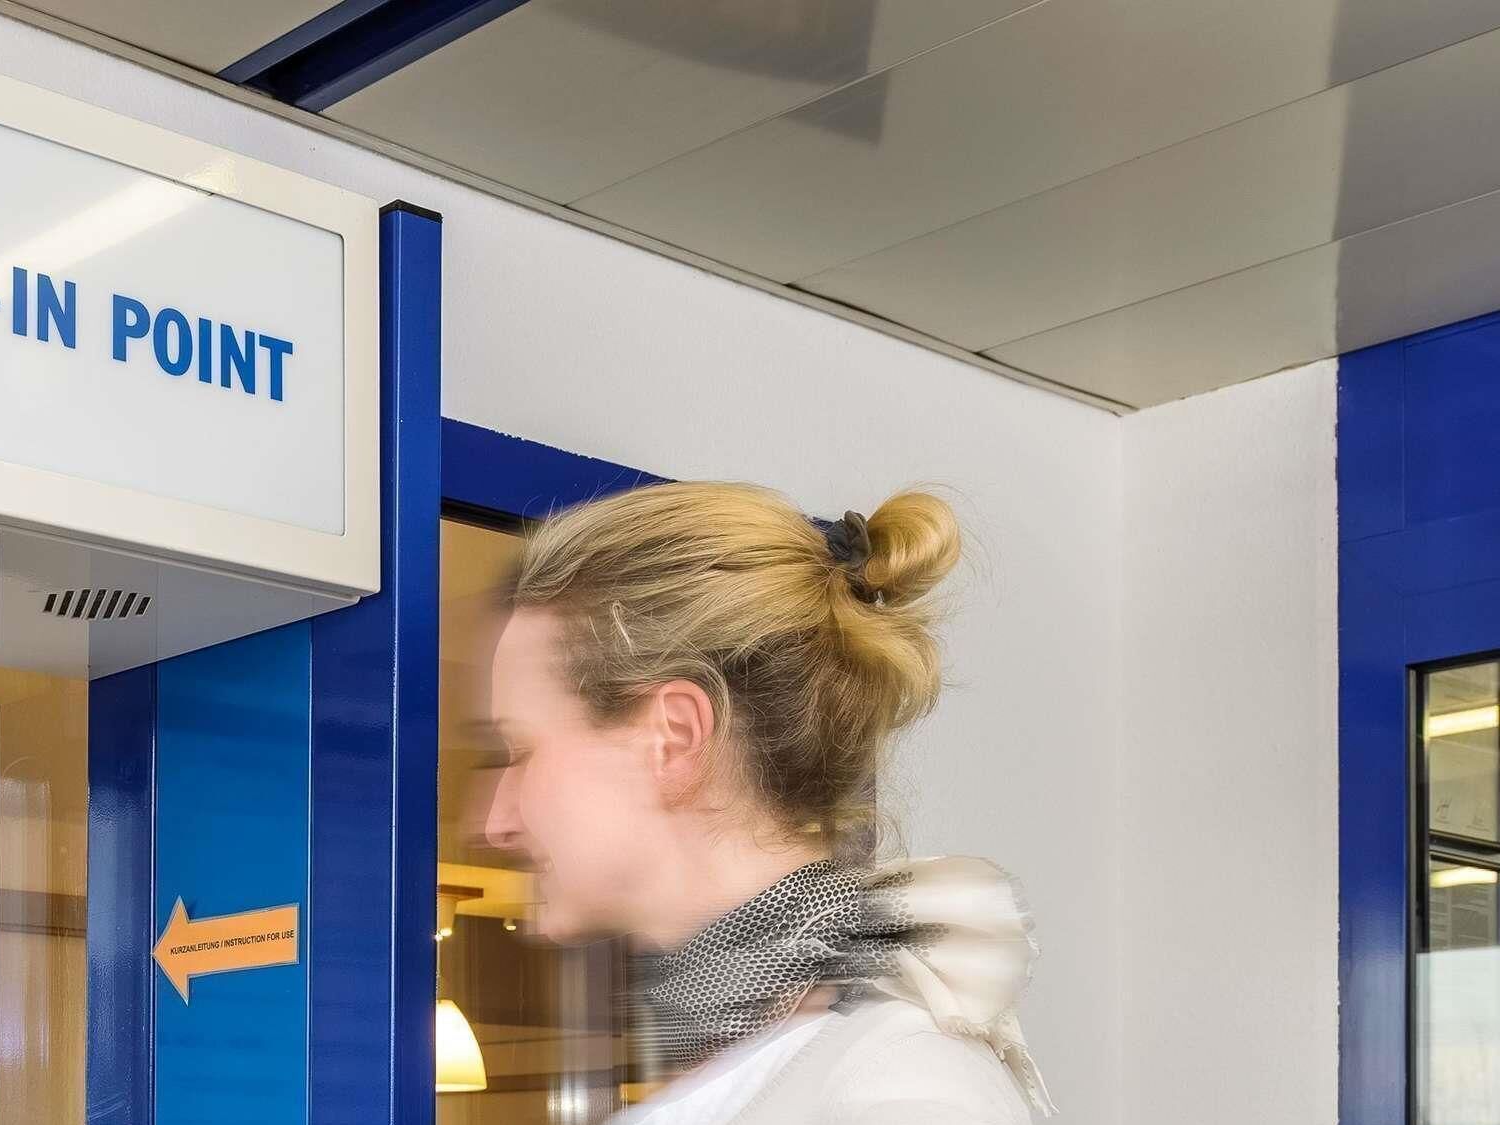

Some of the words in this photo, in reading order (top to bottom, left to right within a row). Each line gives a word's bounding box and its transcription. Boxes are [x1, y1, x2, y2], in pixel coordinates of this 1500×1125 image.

[112, 293, 293, 402] POINT
[170, 941, 220, 955] KURZANLEITUNG
[224, 934, 266, 948] INSTRUCTION
[267, 932, 280, 941] FOR
[281, 930, 295, 939] USE
